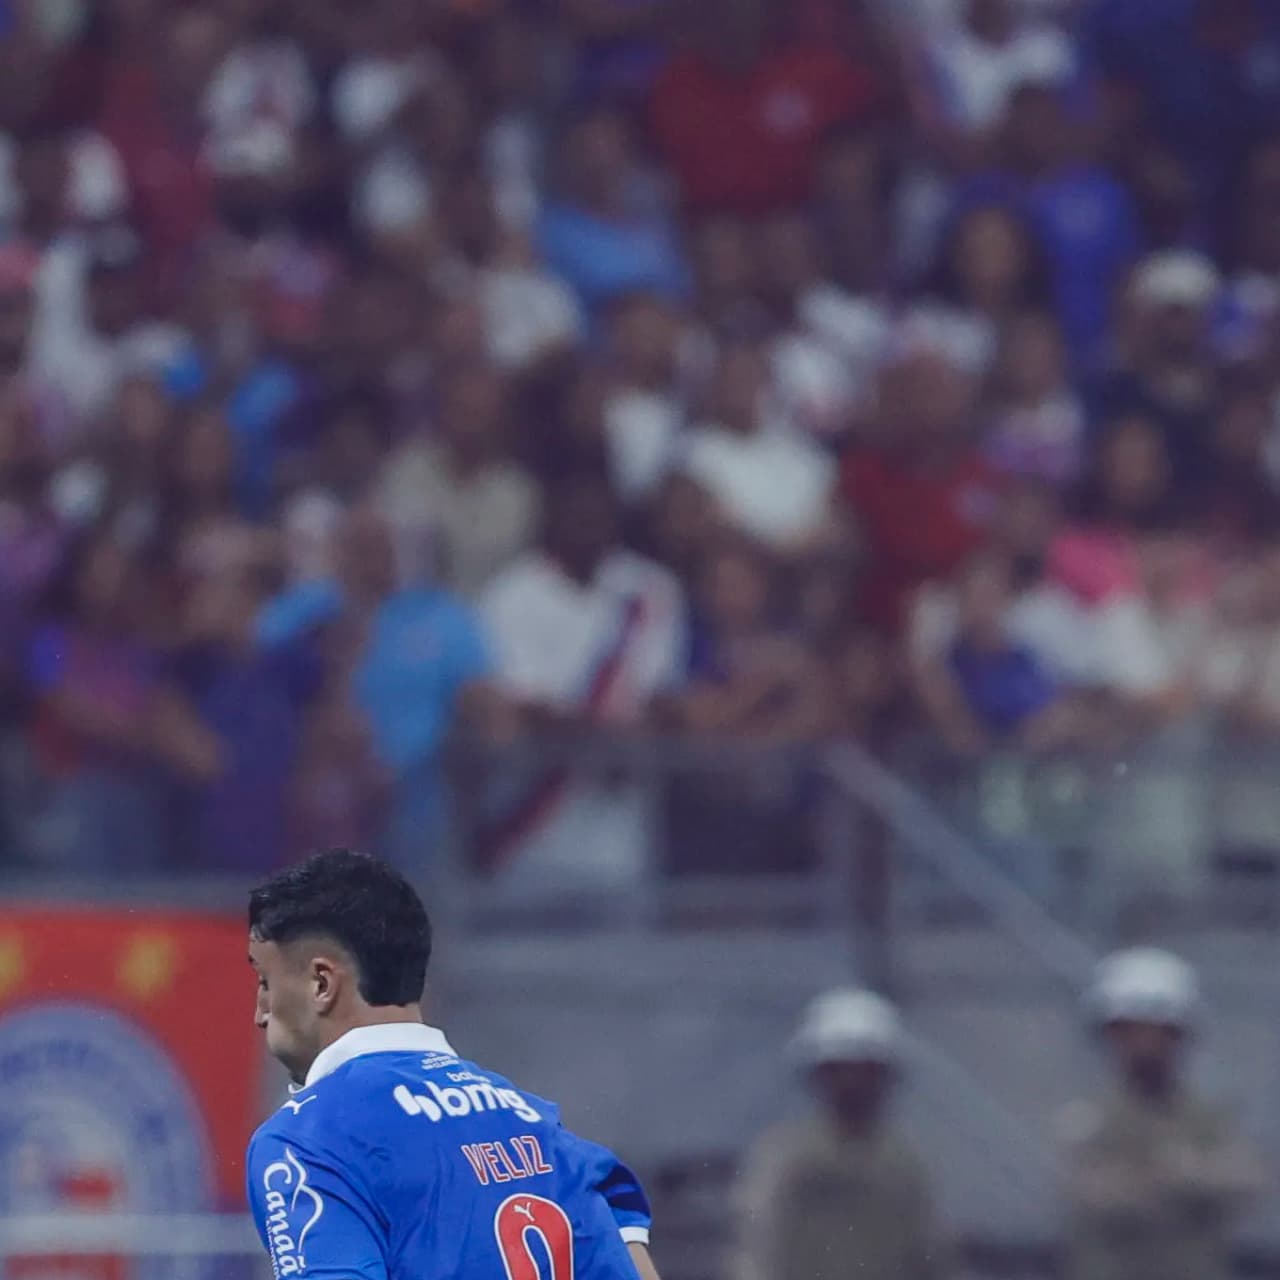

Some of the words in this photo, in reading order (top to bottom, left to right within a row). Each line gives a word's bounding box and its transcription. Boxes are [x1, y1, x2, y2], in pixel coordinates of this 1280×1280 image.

[424, 1081, 542, 1123] bmg
[461, 1135, 553, 1185] VELIZ
[263, 1162, 306, 1277] Canaã
